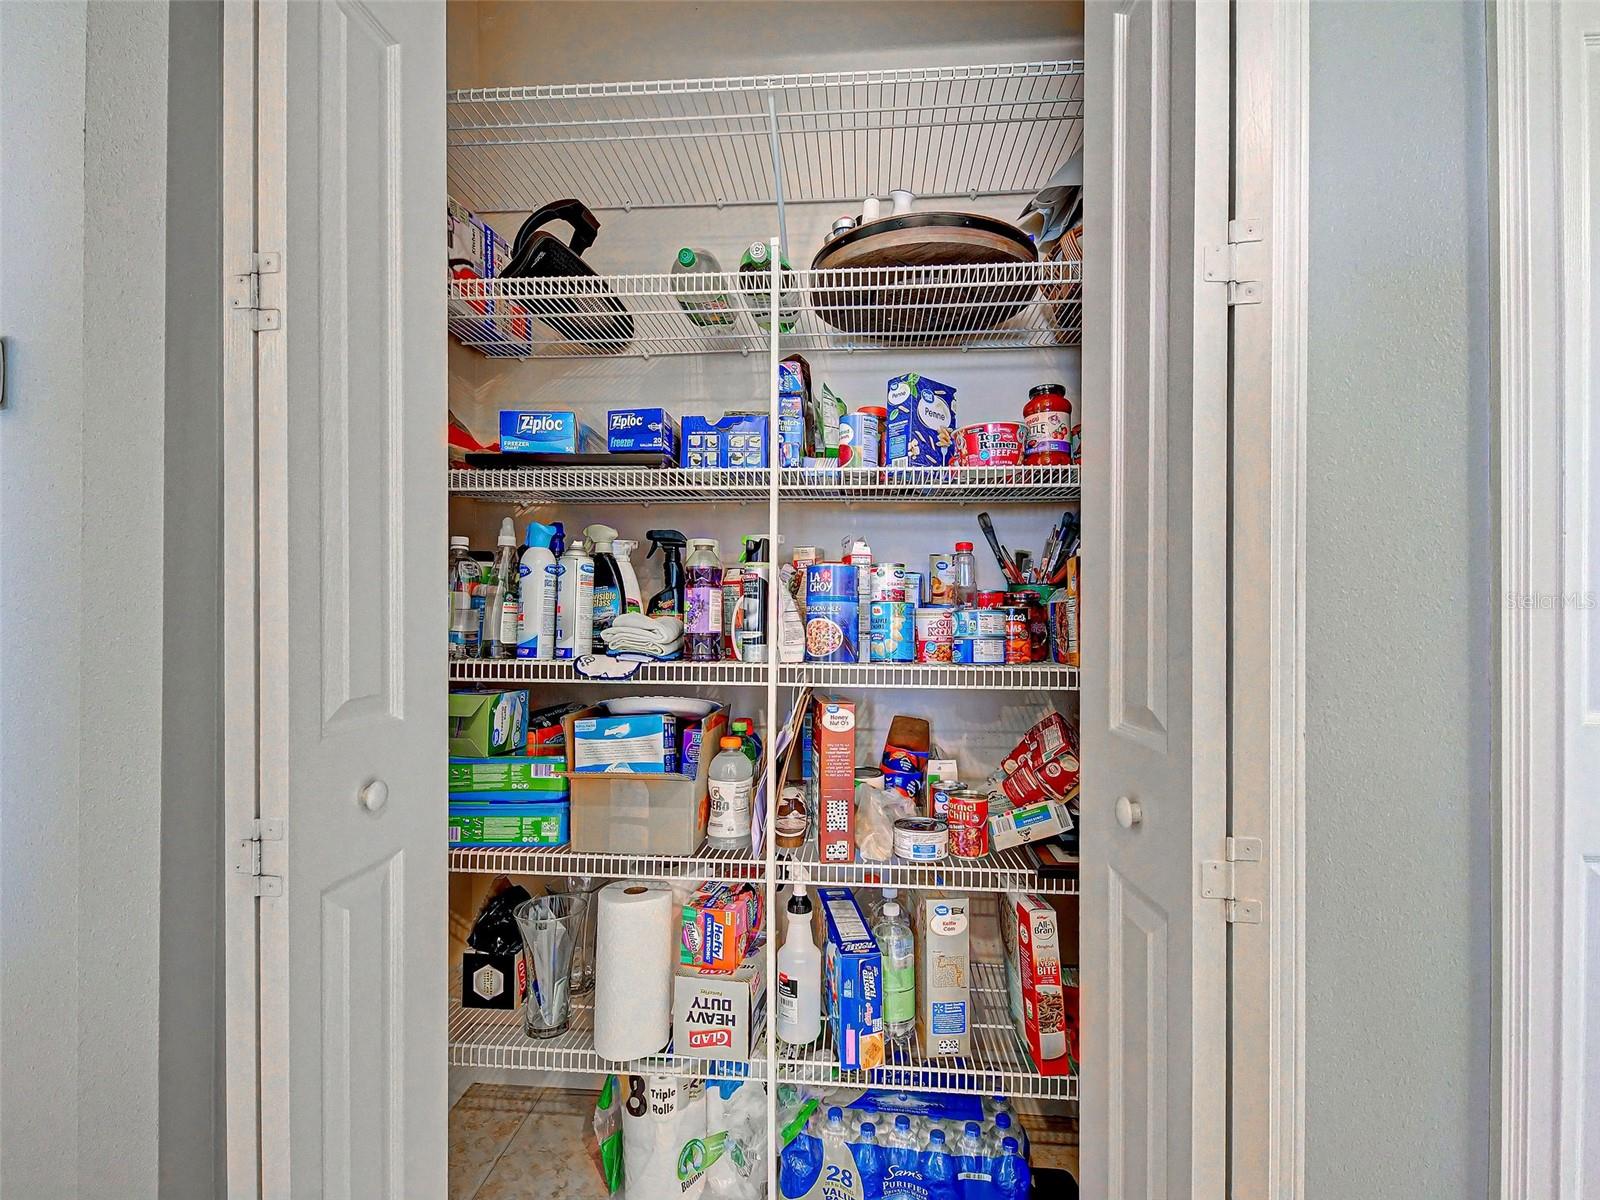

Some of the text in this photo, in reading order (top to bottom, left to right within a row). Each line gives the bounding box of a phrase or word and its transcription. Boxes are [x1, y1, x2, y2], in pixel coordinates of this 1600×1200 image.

[924, 407, 946, 421] Penne
[520, 415, 563, 434] Ziploc
[612, 414, 644, 430] Ziploc
[978, 432, 1000, 442] Top
[979, 441, 1018, 450] Ramen
[991, 449, 1012, 457] BEEF
[810, 571, 820, 582] LA
[810, 582, 832, 592] CHOY
[1005, 613, 1027, 622] ruce's
[1005, 624, 1022, 633] AMS
[709, 799, 730, 812] ERO
[949, 803, 977, 812] ormel
[949, 810, 970, 821] Chili
[1034, 926, 1053, 935] Bran
[1037, 920, 1051, 929] All-
[712, 924, 724, 957] Hefty
[1037, 966, 1057, 976] BITE
[691, 996, 732, 1012] DUTY
[685, 1010, 736, 1027] HEAVY
[690, 1031, 729, 1045] GLAD
[625, 1075, 648, 1118] 8
[650, 1087, 676, 1102] Triple
[652, 1103, 675, 1116] Rolls
[825, 1164, 853, 1188] 28
[883, 1164, 924, 1181] Sam's
[882, 1180, 929, 1196] PURIFIED
